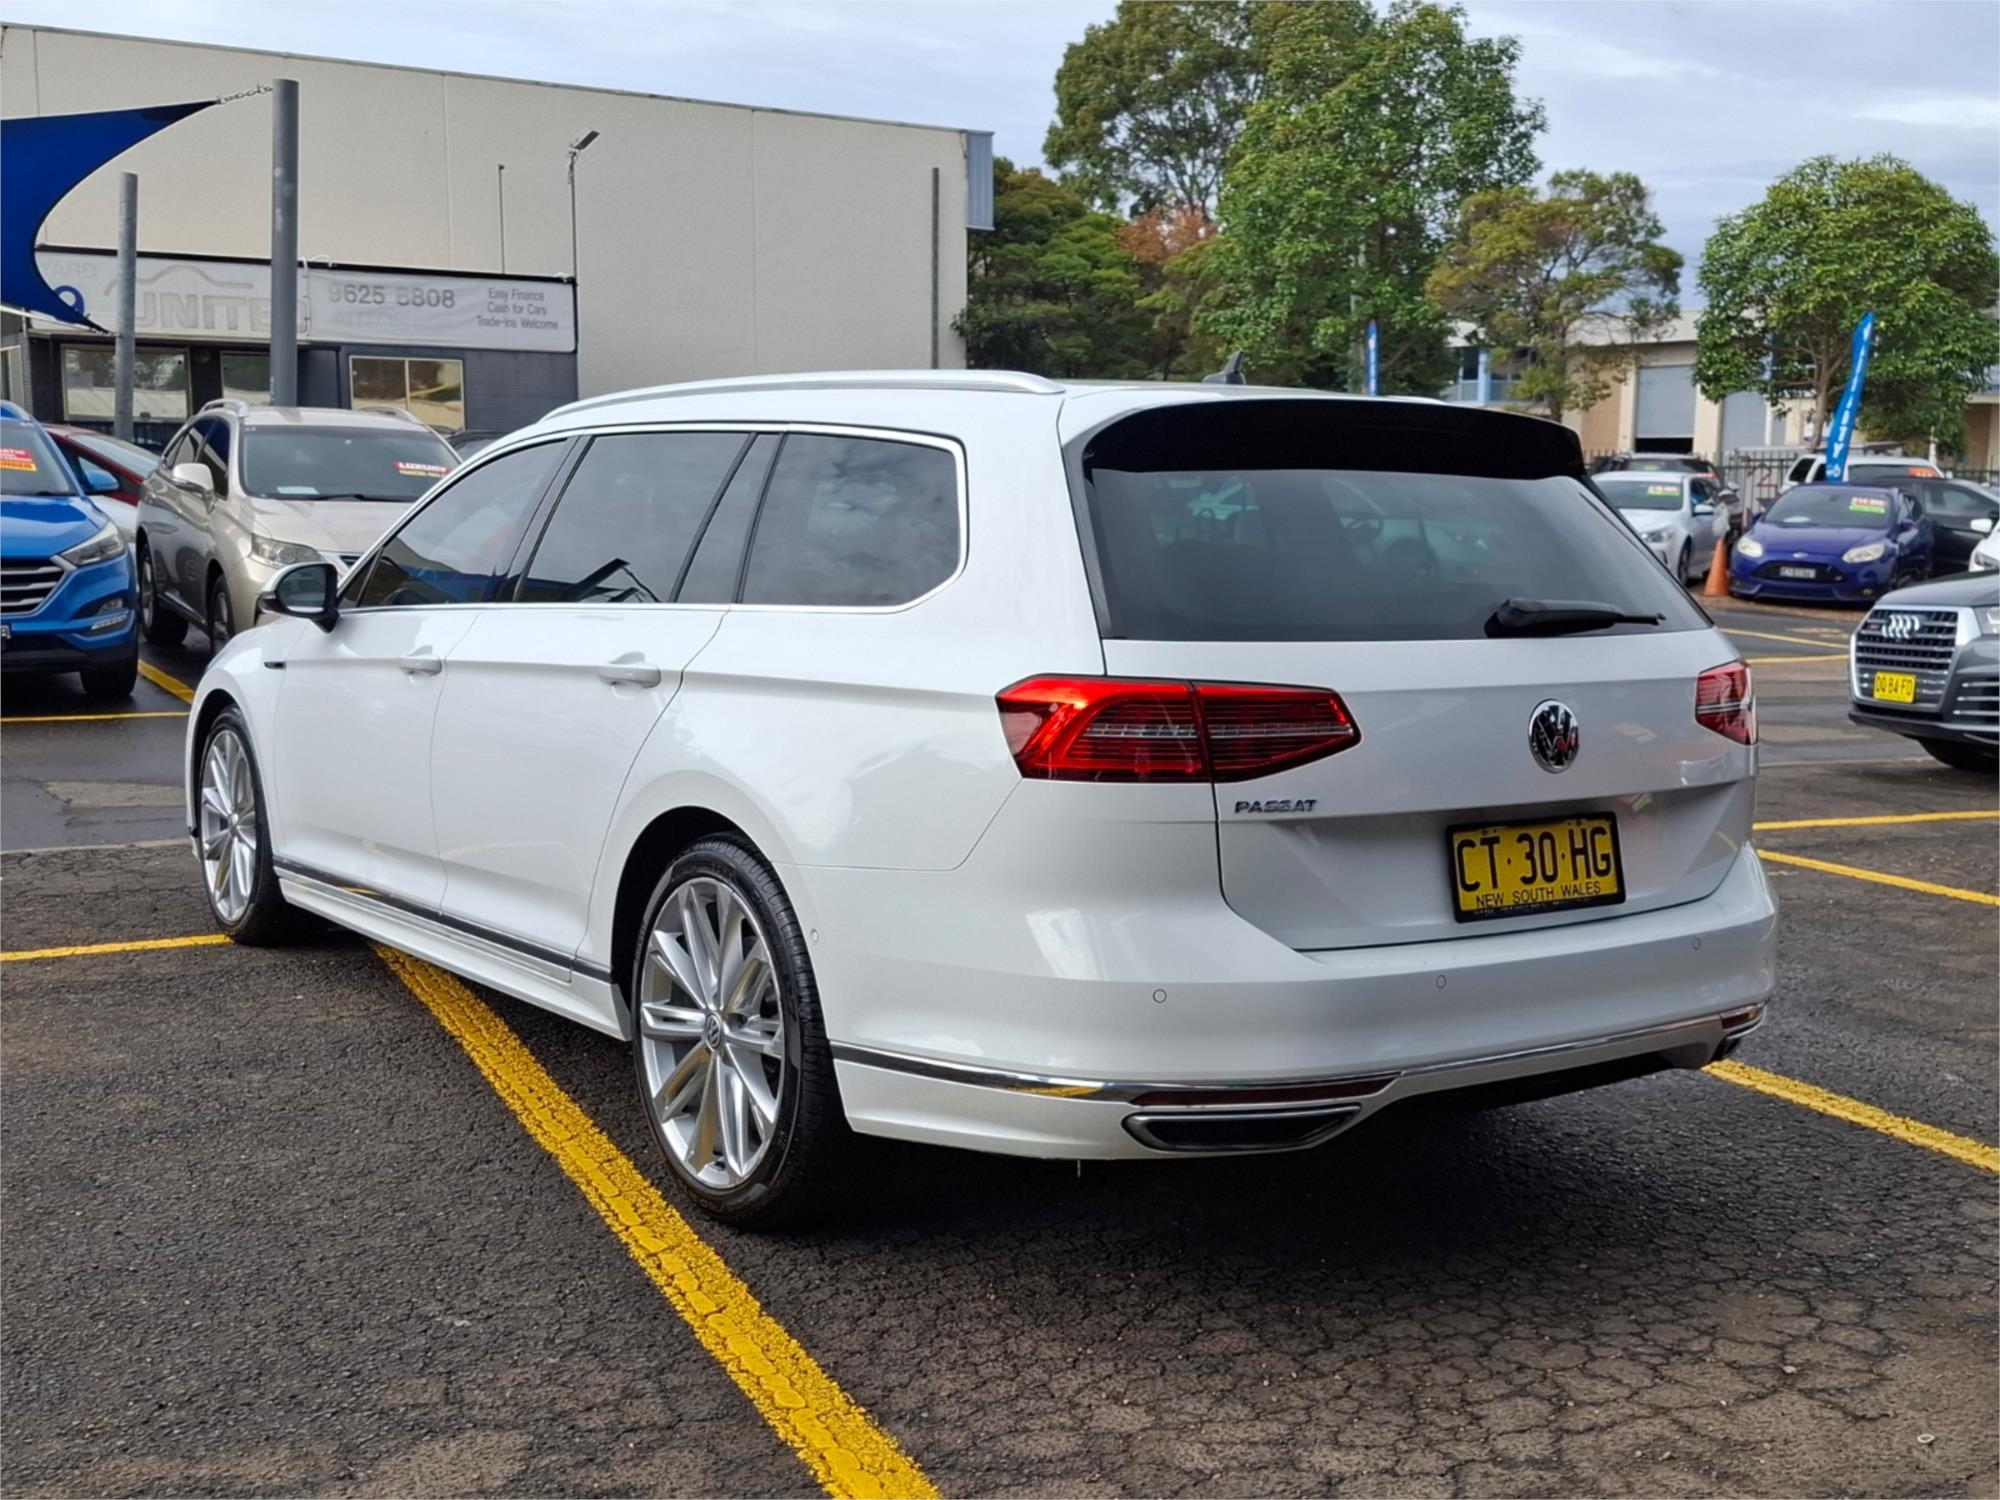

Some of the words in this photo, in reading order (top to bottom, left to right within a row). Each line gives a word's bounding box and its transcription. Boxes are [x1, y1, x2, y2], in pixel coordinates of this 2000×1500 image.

[488, 287, 509, 302] Easy
[511, 288, 545, 302] Finance
[487, 301, 510, 314] Cash
[512, 303, 525, 315] for
[527, 303, 547, 316] Cars
[520, 318, 559, 330] Welcome
[1234, 799, 1317, 814] PASSAT
[1476, 891, 1505, 908] NEW
[1512, 886, 1554, 905] SOUTH
[1560, 881, 1601, 898] WALES
